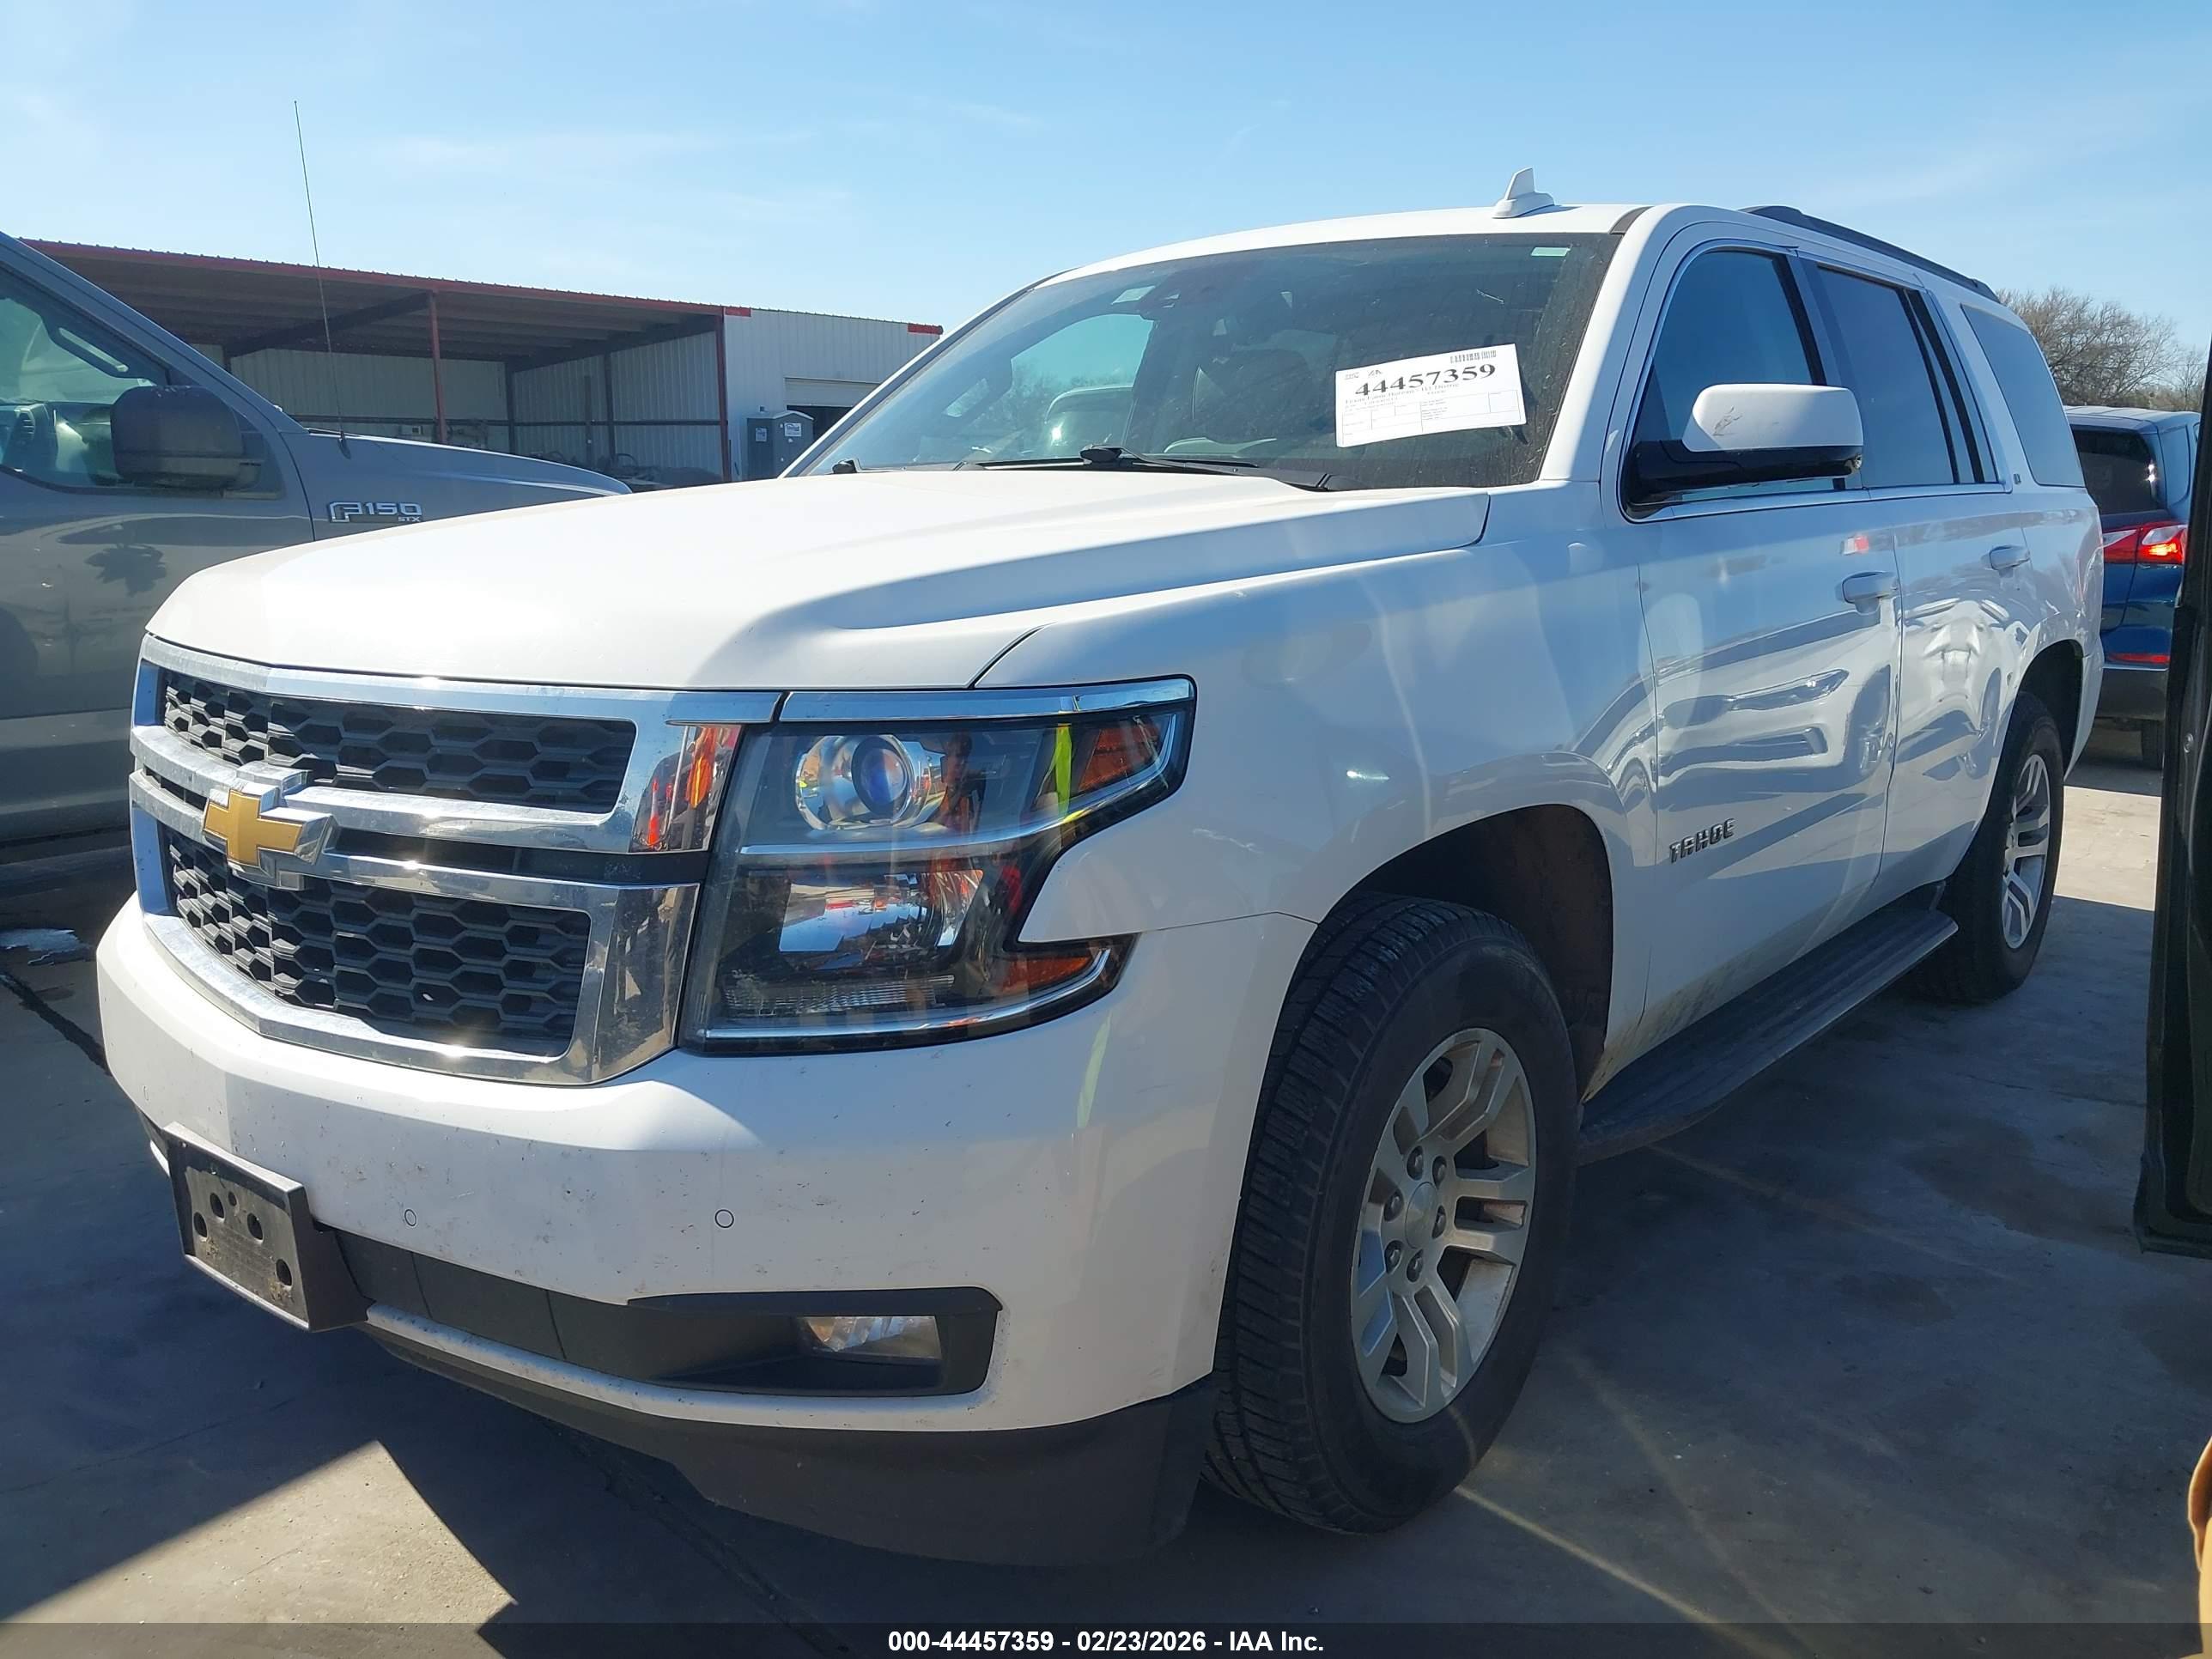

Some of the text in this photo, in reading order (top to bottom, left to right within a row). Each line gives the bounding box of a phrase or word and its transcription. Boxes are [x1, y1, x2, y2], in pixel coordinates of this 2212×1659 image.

[1355, 363, 1496, 396] 44457359
[329, 501, 422, 522] F150
[1669, 817, 1735, 864] TAHOE
